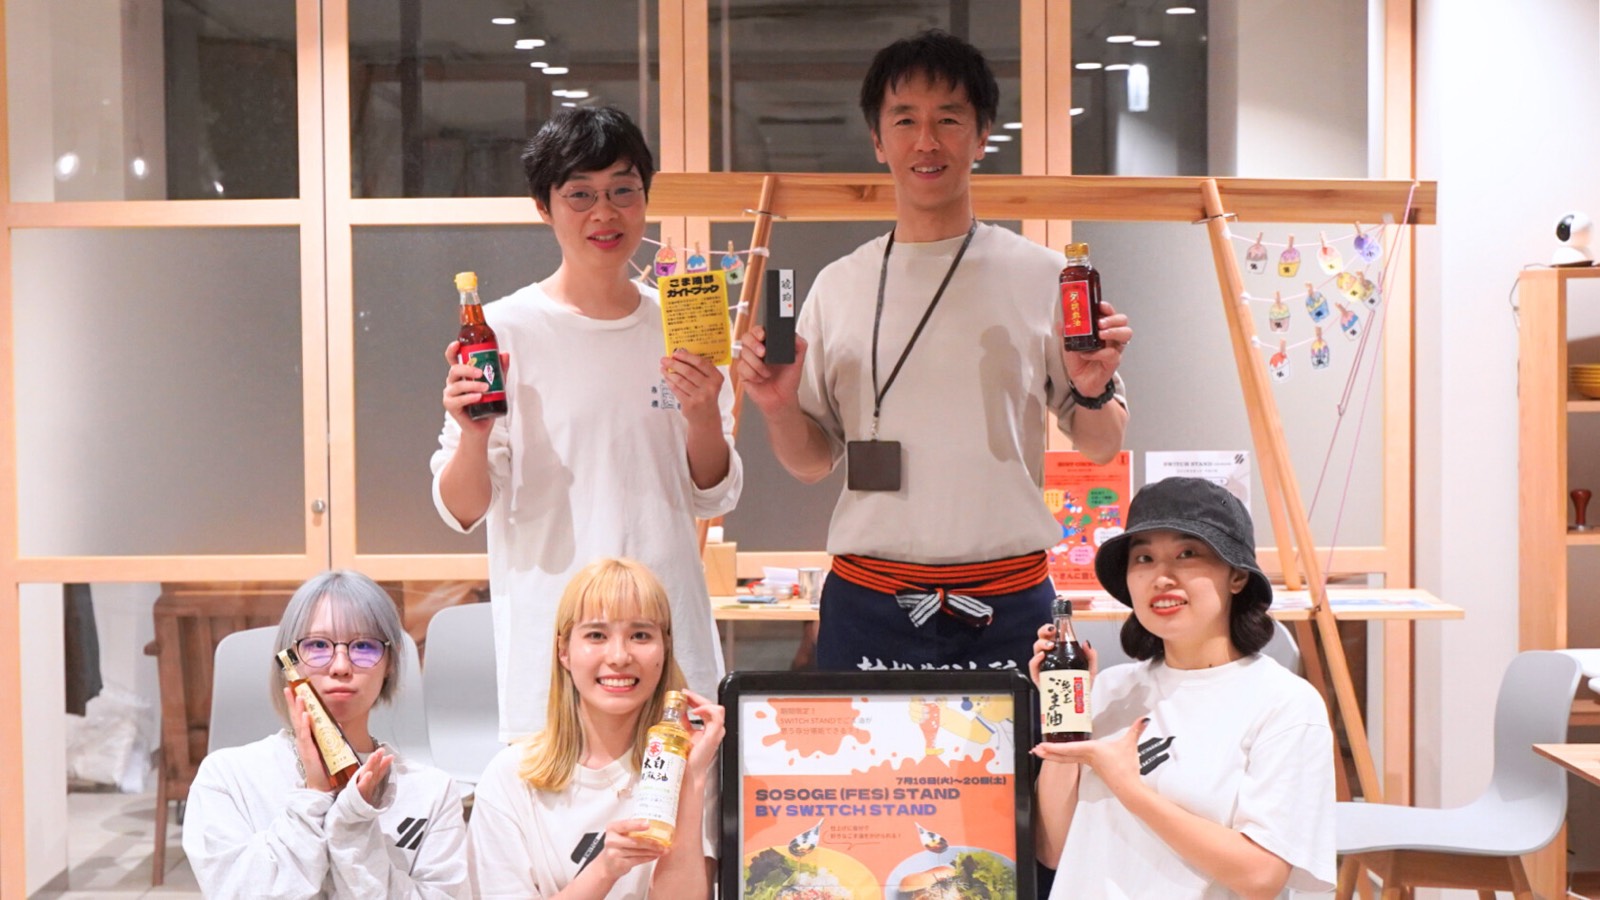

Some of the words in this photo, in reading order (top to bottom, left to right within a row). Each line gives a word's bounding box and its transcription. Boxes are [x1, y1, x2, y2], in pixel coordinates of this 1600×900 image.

[641, 771, 669, 781] 麻油
[755, 788, 837, 800] SOSOGE
[840, 788, 889, 800] (FES)
[893, 788, 960, 800] STAND
[755, 804, 779, 816] BY
[786, 804, 866, 816] SWITCH
[870, 803, 936, 816] STAND
